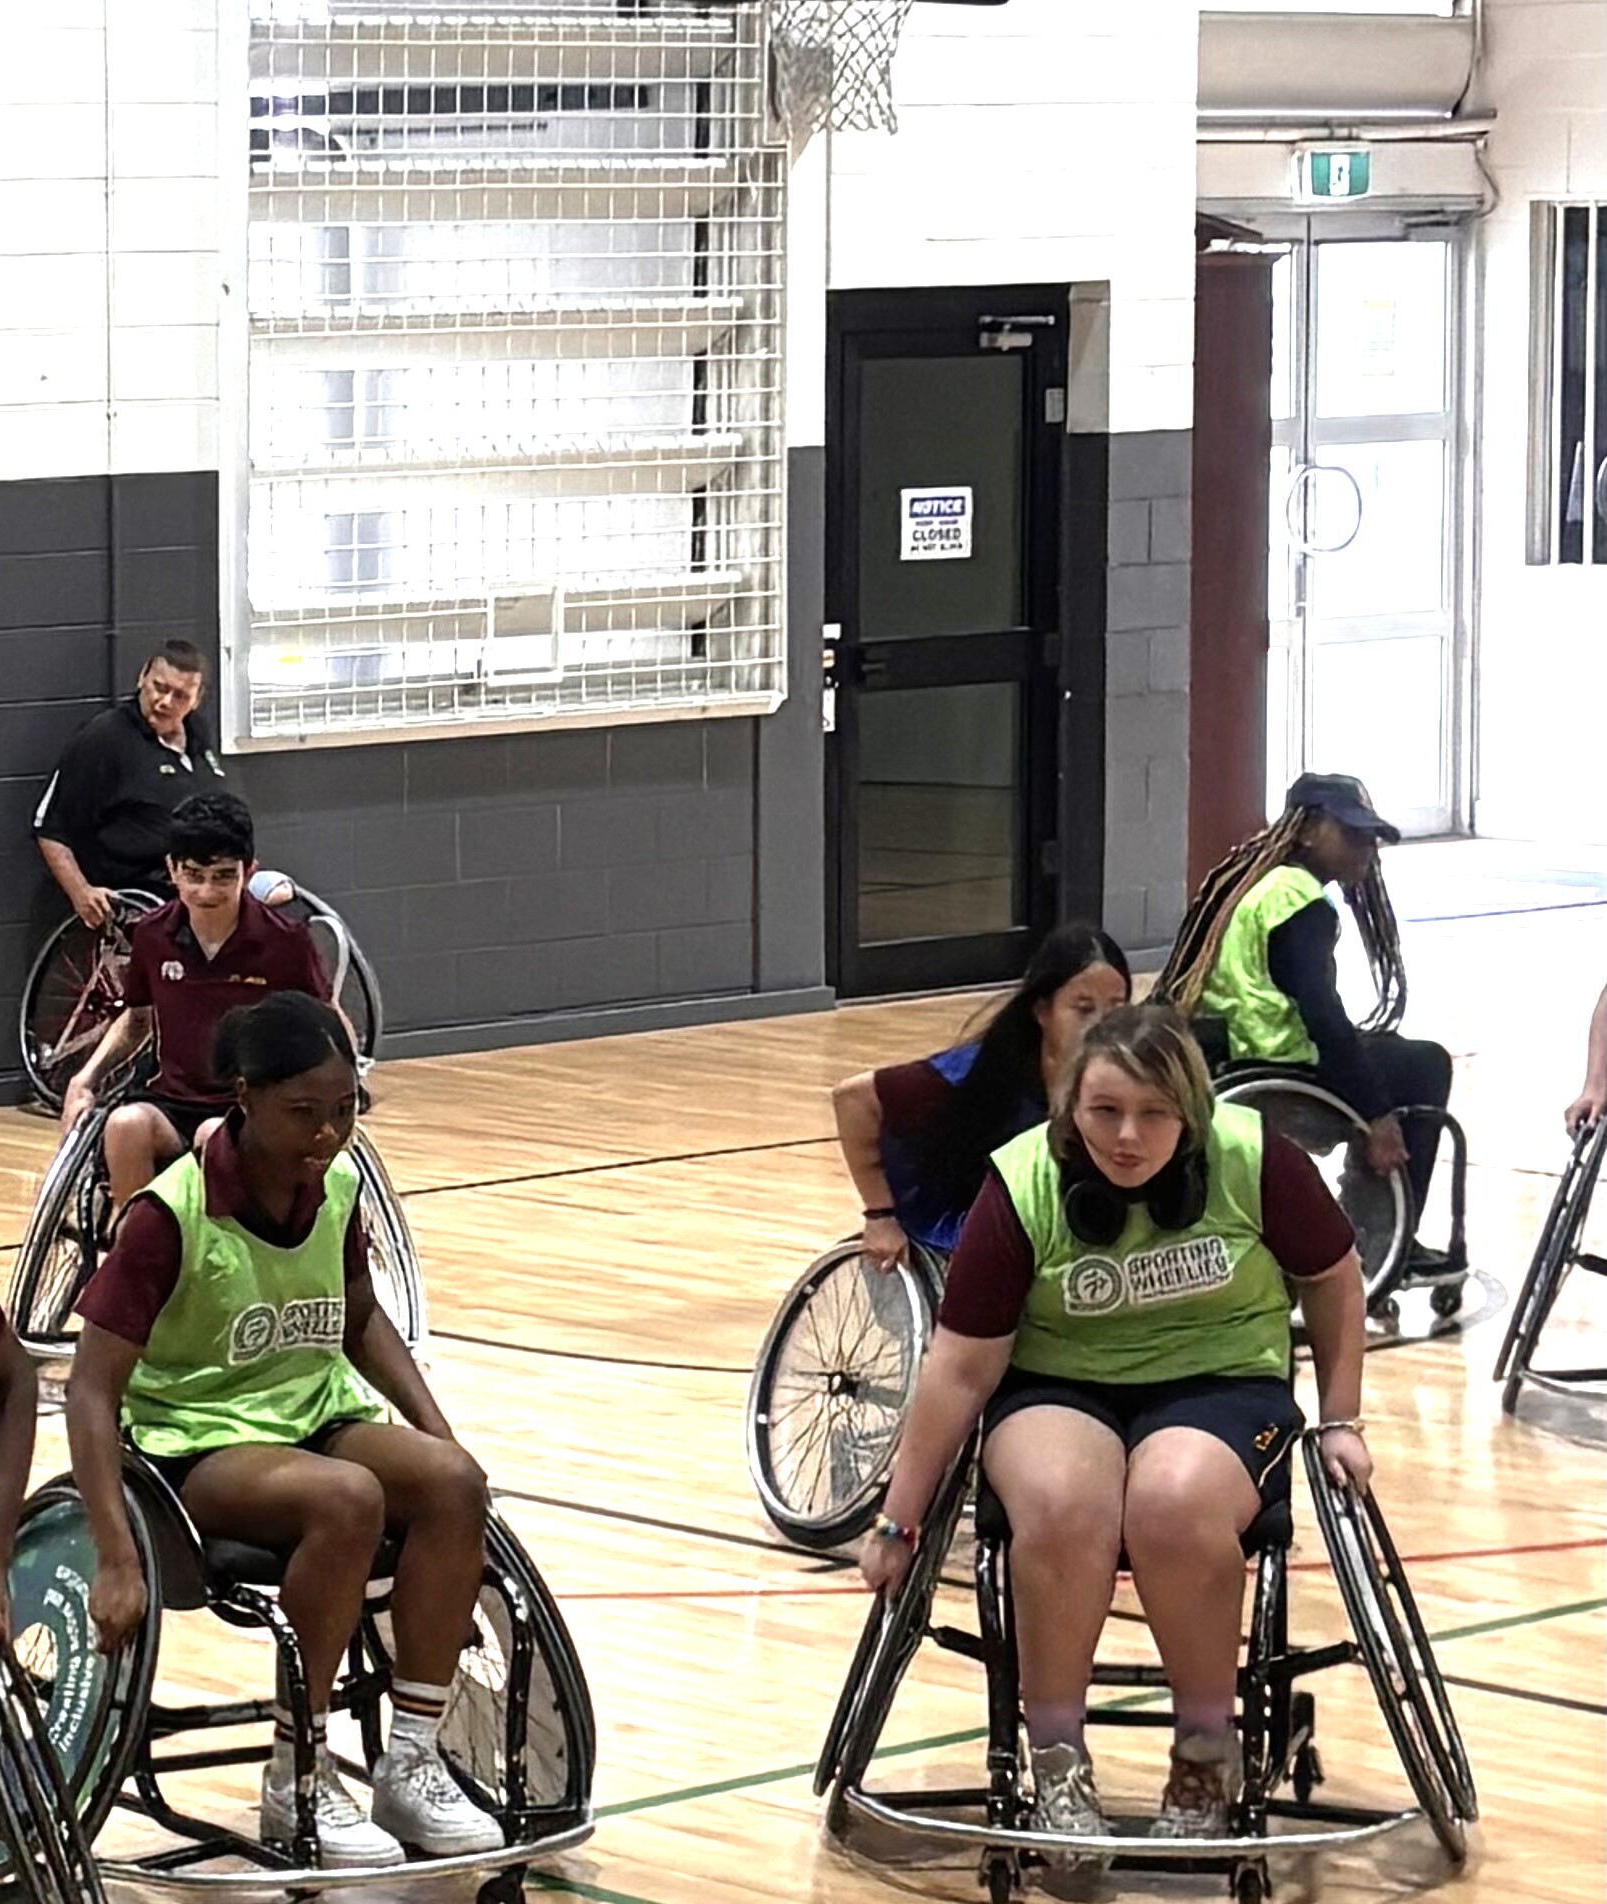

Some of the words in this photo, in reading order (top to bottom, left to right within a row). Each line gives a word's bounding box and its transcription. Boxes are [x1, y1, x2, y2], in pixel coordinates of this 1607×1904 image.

[912, 499, 964, 514] NOTICE
[912, 528, 962, 542] CLOSED
[1129, 1238, 1222, 1275] SPORTING
[48, 1656, 81, 1745] Creating
[58, 1656, 96, 1753] Inclusive
